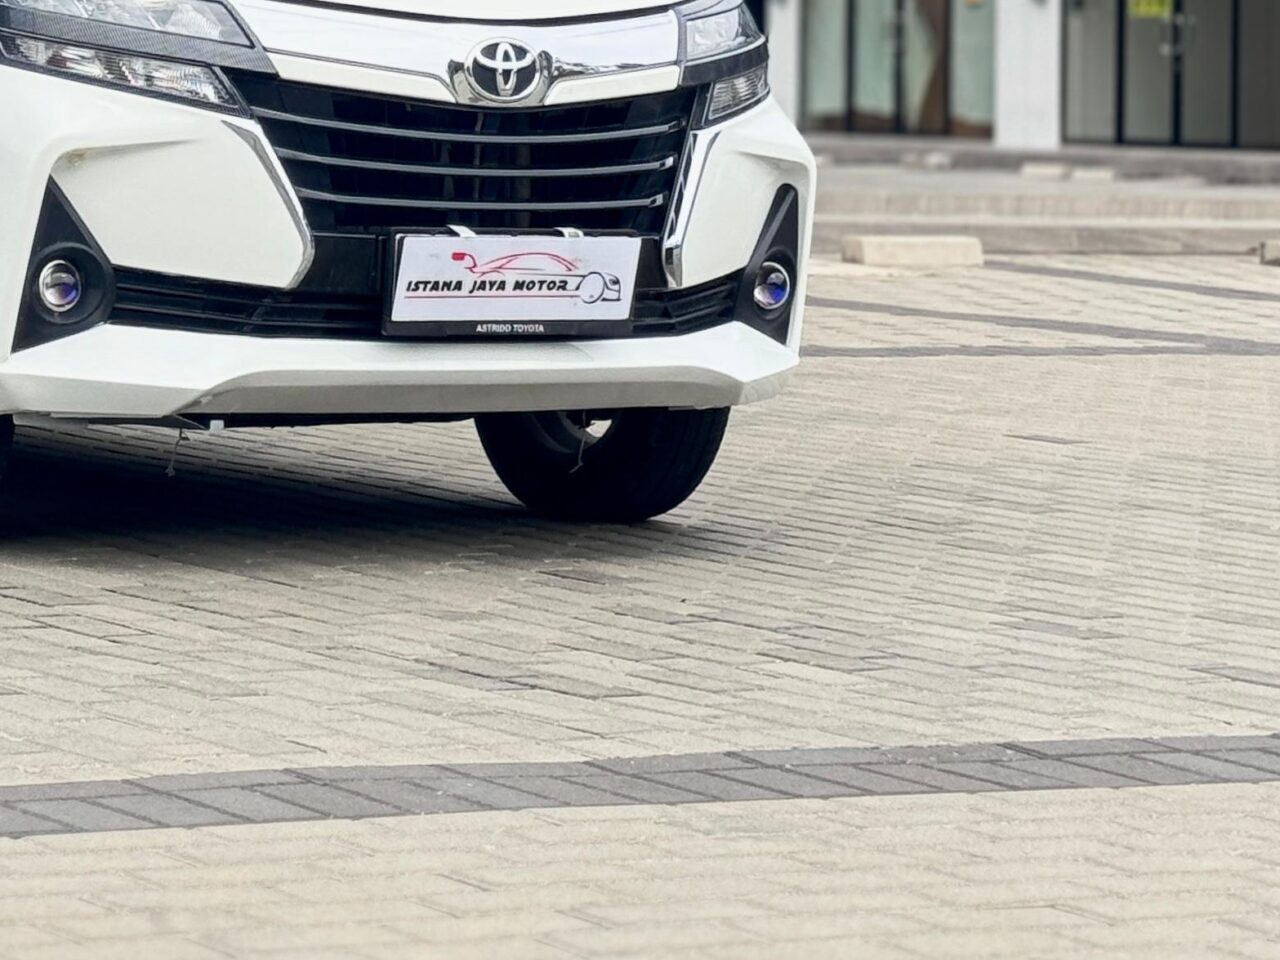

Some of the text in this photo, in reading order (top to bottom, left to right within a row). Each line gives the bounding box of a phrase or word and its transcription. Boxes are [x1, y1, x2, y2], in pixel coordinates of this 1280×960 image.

[406, 280, 568, 294] ISTANA JAYA MOTOR
[475, 323, 545, 333] ASTRIDO TOYOTA
